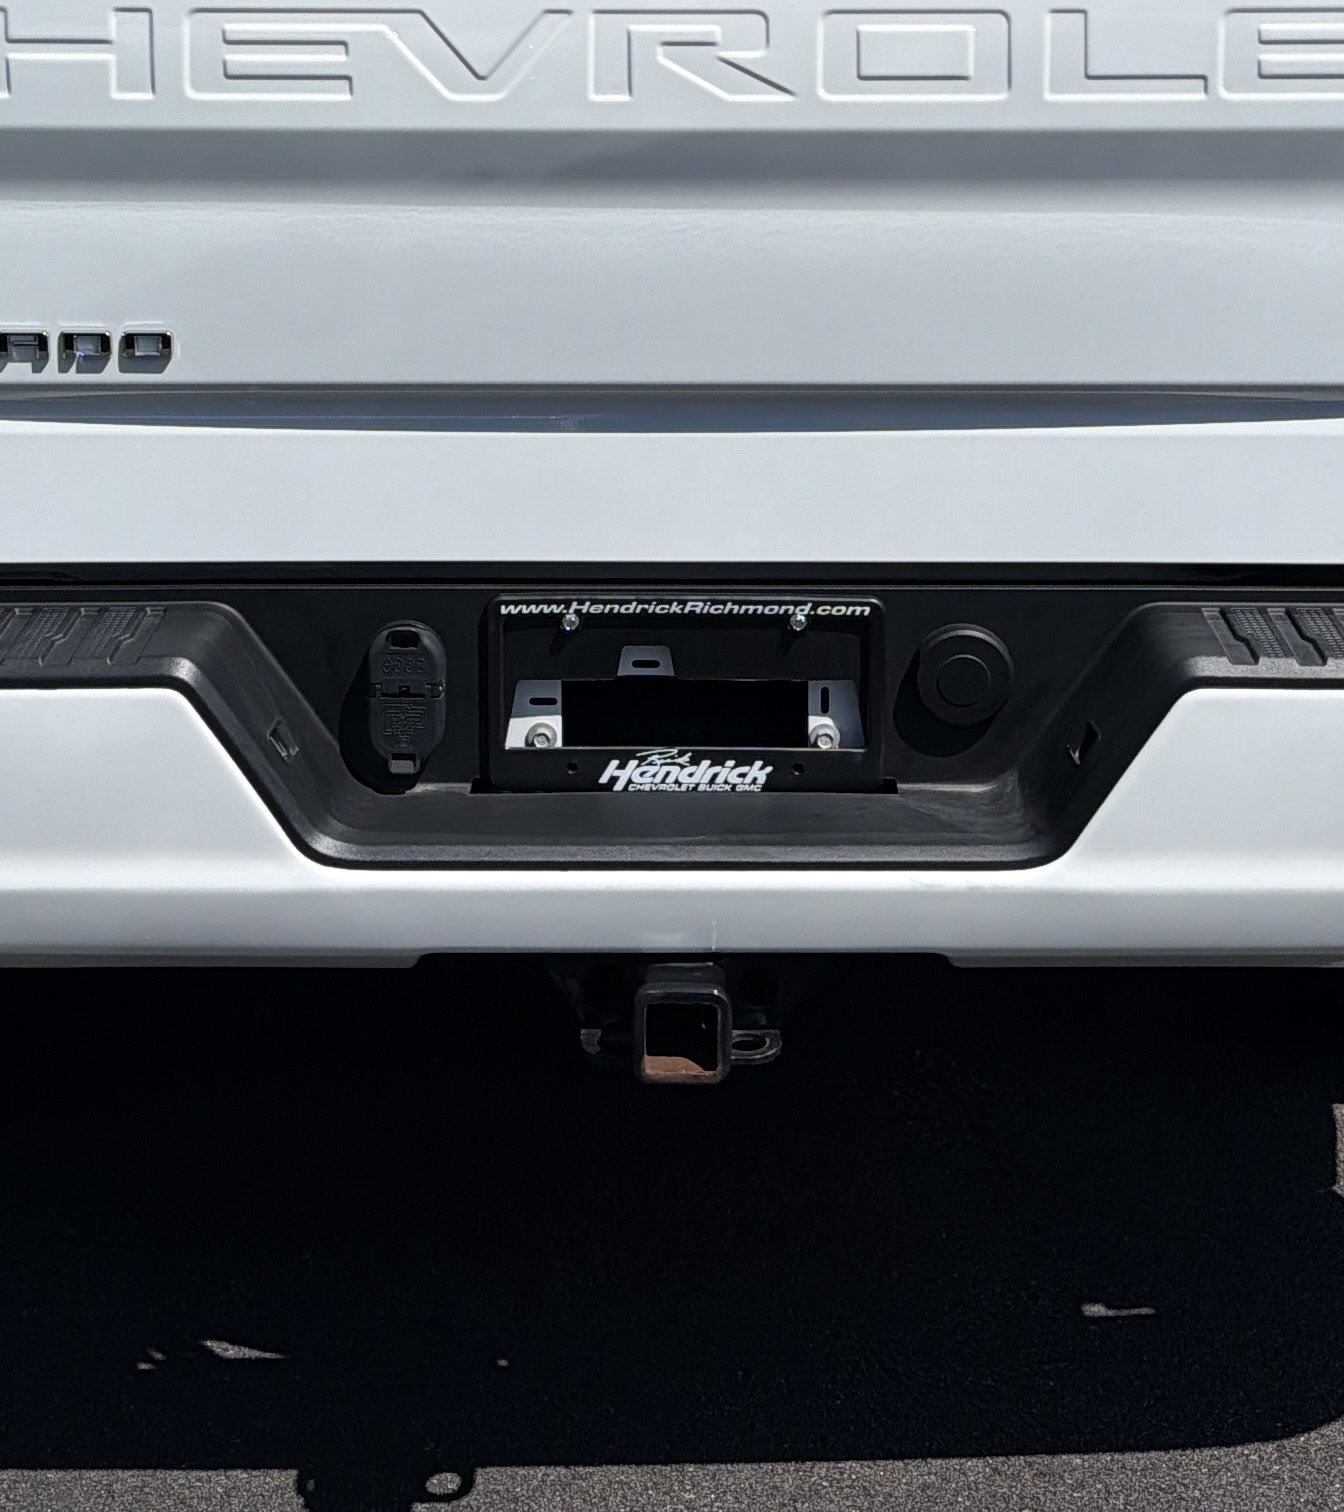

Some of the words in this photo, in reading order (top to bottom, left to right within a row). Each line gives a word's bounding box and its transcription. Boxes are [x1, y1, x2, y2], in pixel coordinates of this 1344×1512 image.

[500, 601, 871, 617] www.HendrickRichmond.com
[598, 759, 774, 792] Hendrick
[627, 783, 696, 792] CHEVROLET
[697, 783, 732, 792] BUICK
[735, 784, 763, 792] GMC
